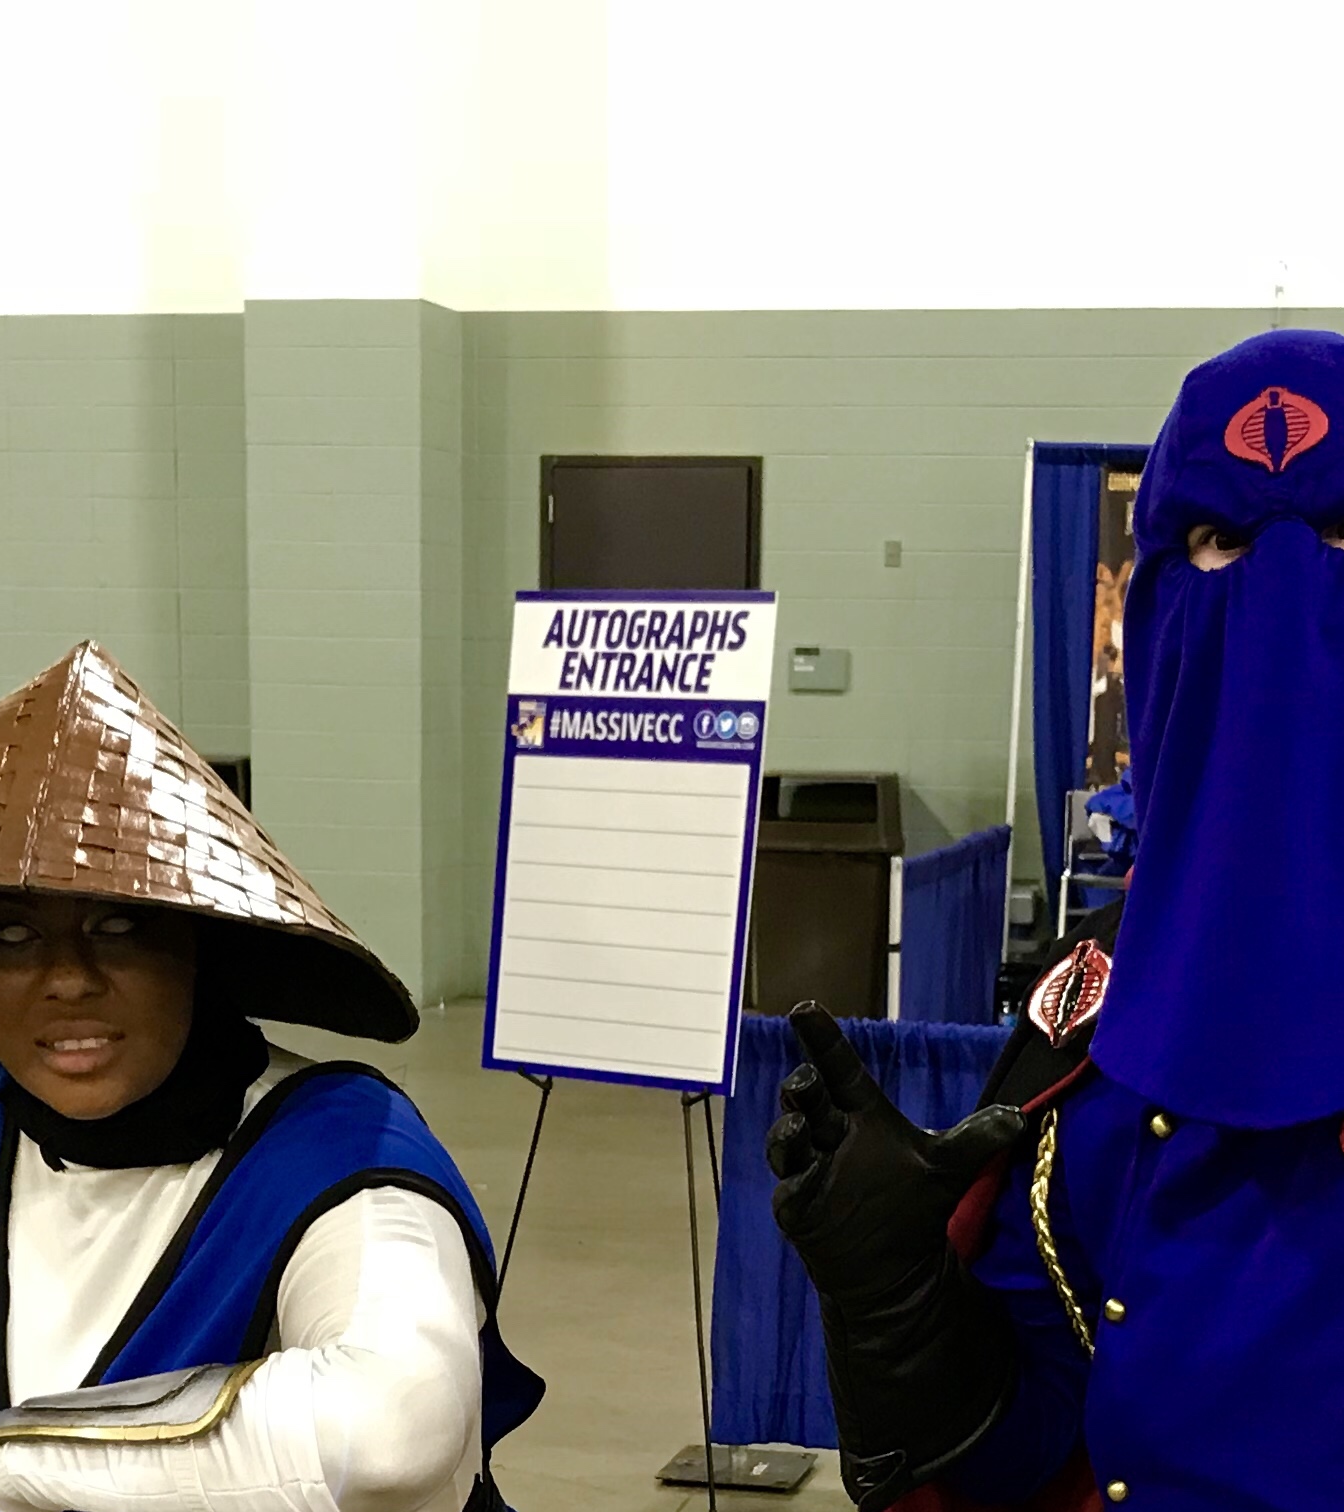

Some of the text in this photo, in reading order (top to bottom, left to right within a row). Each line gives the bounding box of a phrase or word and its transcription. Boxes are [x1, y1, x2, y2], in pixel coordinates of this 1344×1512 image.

[542, 609, 751, 652] AUTOGRAPHS
[558, 651, 716, 694] ENTRANCE
[549, 709, 684, 743] #MASSIVECC
